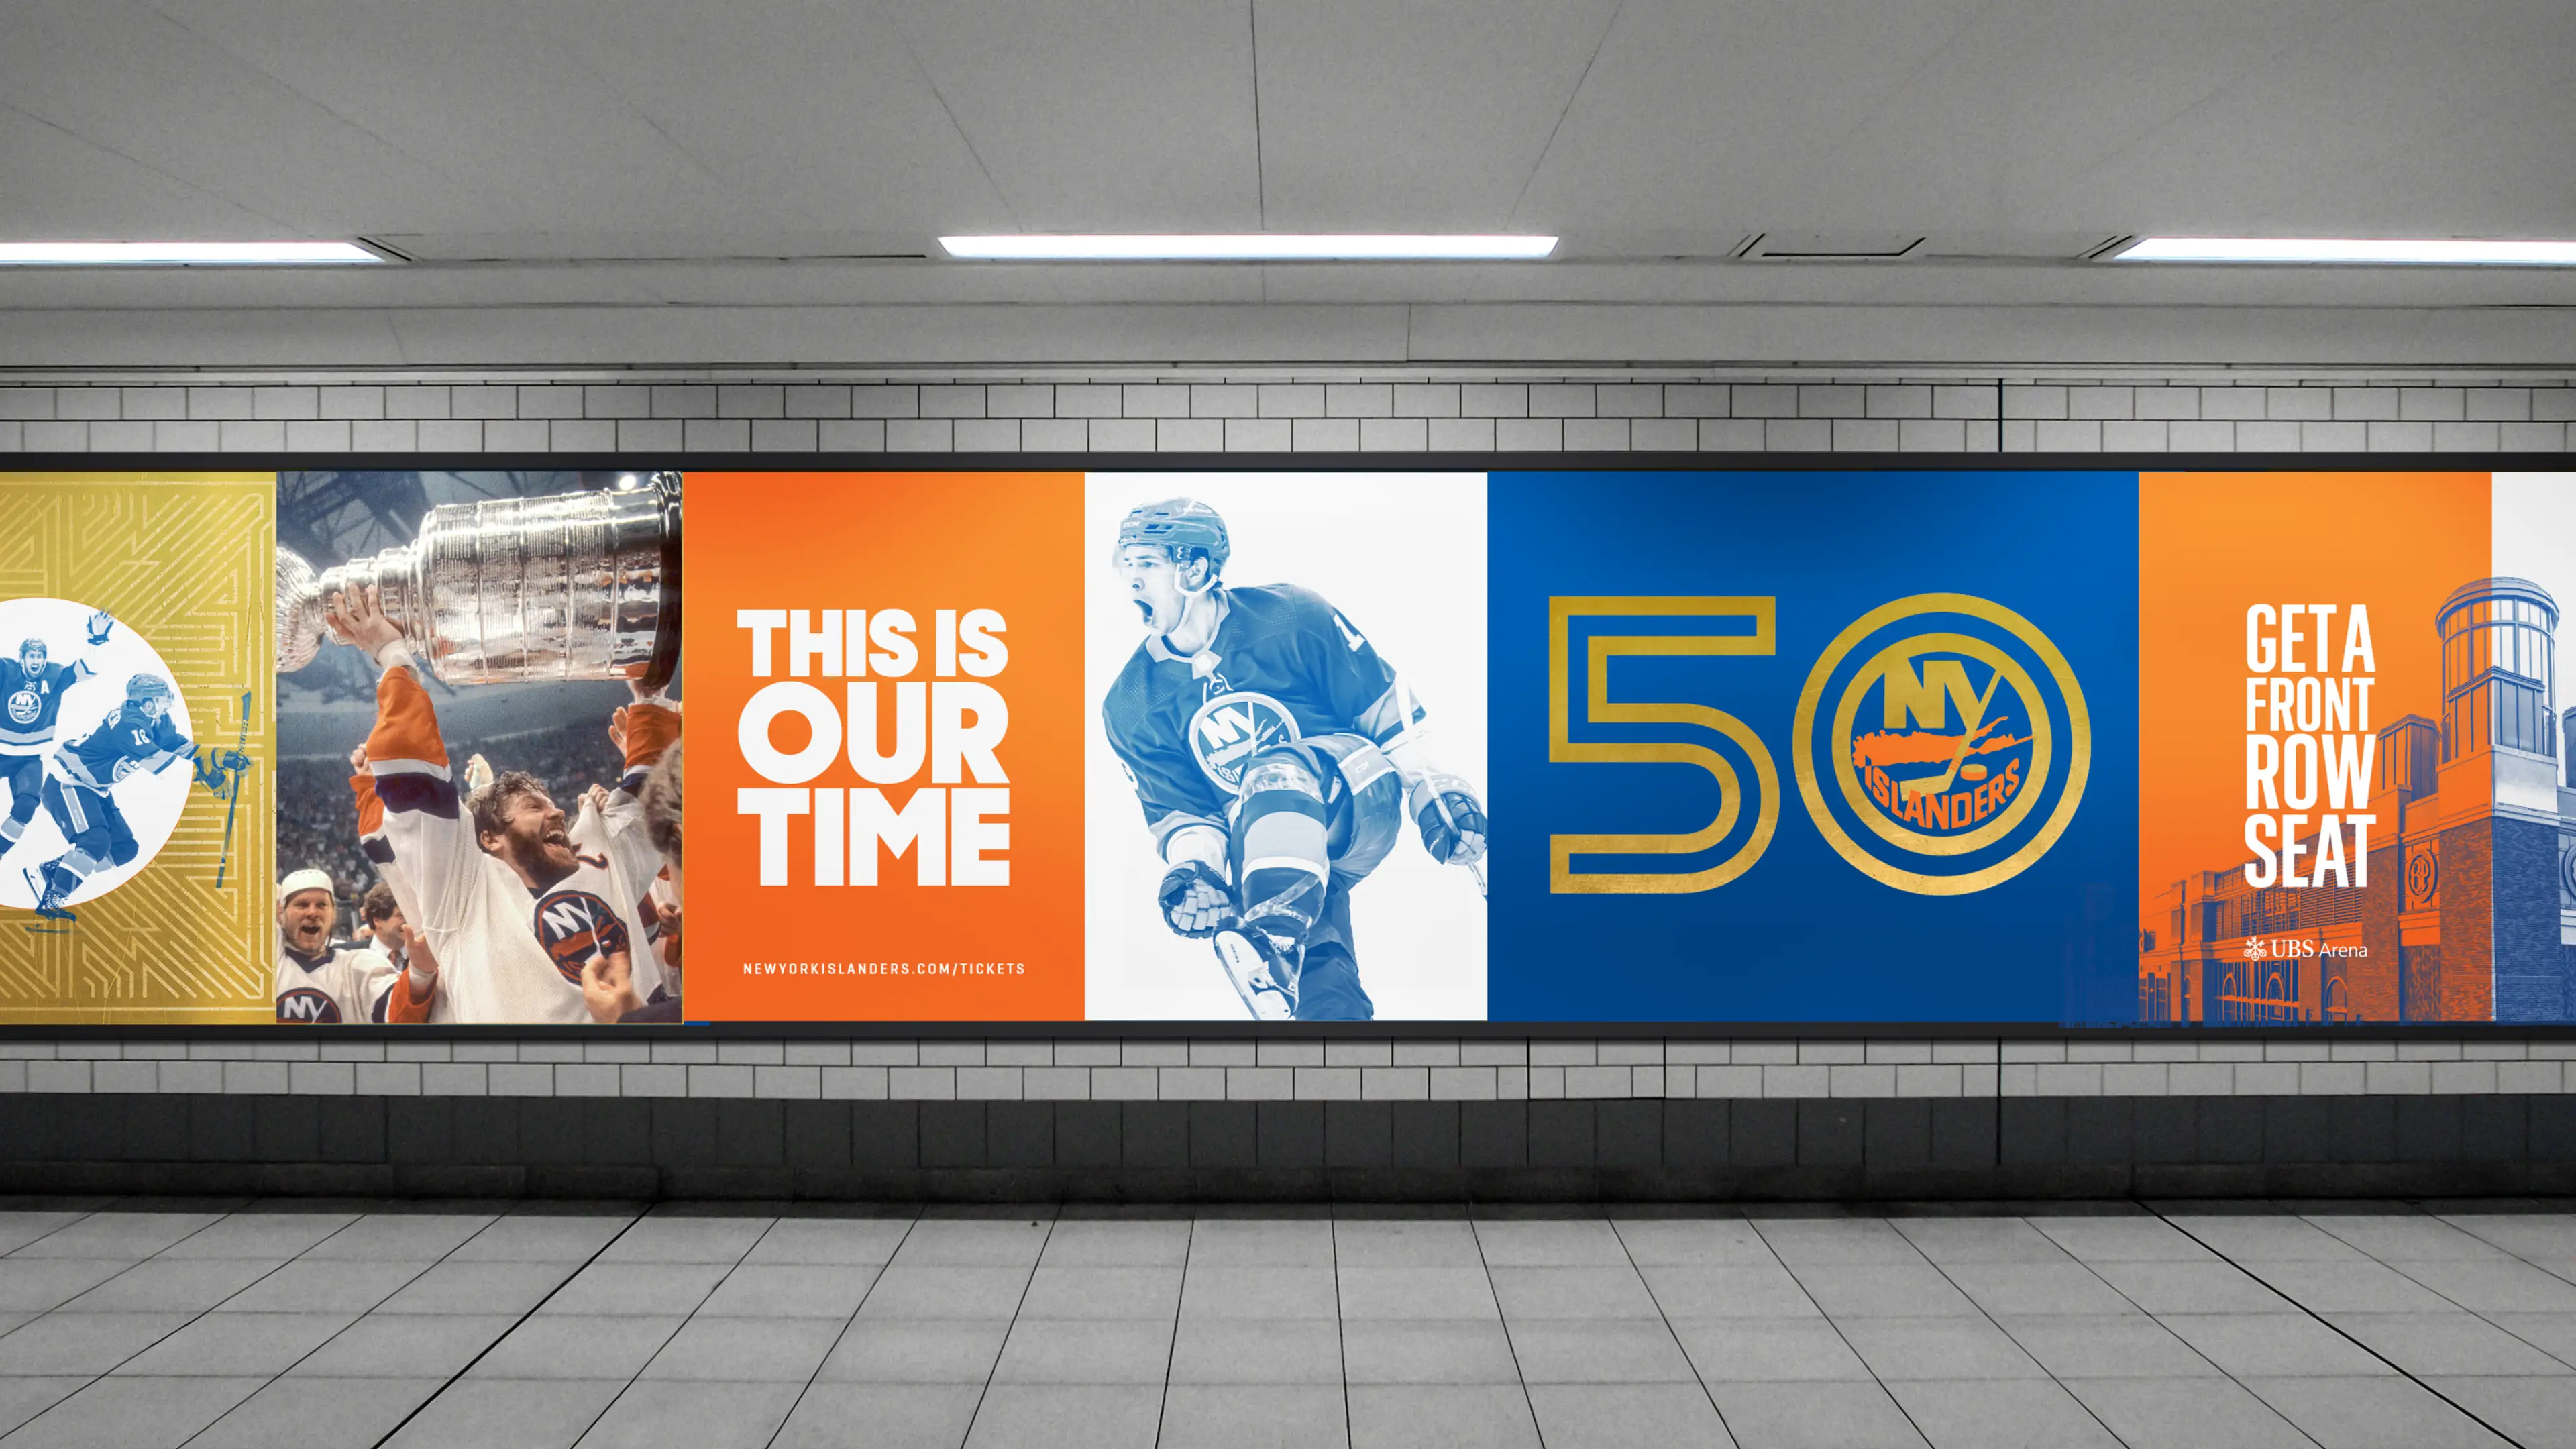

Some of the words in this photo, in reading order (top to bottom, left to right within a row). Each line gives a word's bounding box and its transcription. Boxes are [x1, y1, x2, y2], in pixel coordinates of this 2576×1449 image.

[737, 608, 918, 678] THIS
[936, 608, 1008, 678] IS
[2247, 603, 2337, 673] GET
[2341, 604, 2376, 672] A
[41, 680, 50, 694] A
[1884, 656, 2000, 739] NY
[2246, 676, 2375, 732] FRONT
[131, 729, 150, 746] 18
[738, 681, 1010, 784] OUR
[1199, 703, 1256, 750] NY
[1550, 593, 2090, 895] 50
[1864, 757, 2020, 830] ISLANDERS
[2246, 733, 2377, 810] ROW
[737, 788, 1010, 886] TIME
[2245, 813, 2377, 888] SEAT
[542, 896, 604, 941] NY
[2271, 939, 2314, 958] UBS
[2318, 943, 2368, 958] Arena
[743, 962, 1025, 977] NEWYORKISLANDERS.COM/TICKETS
[283, 996, 327, 1024] NY
